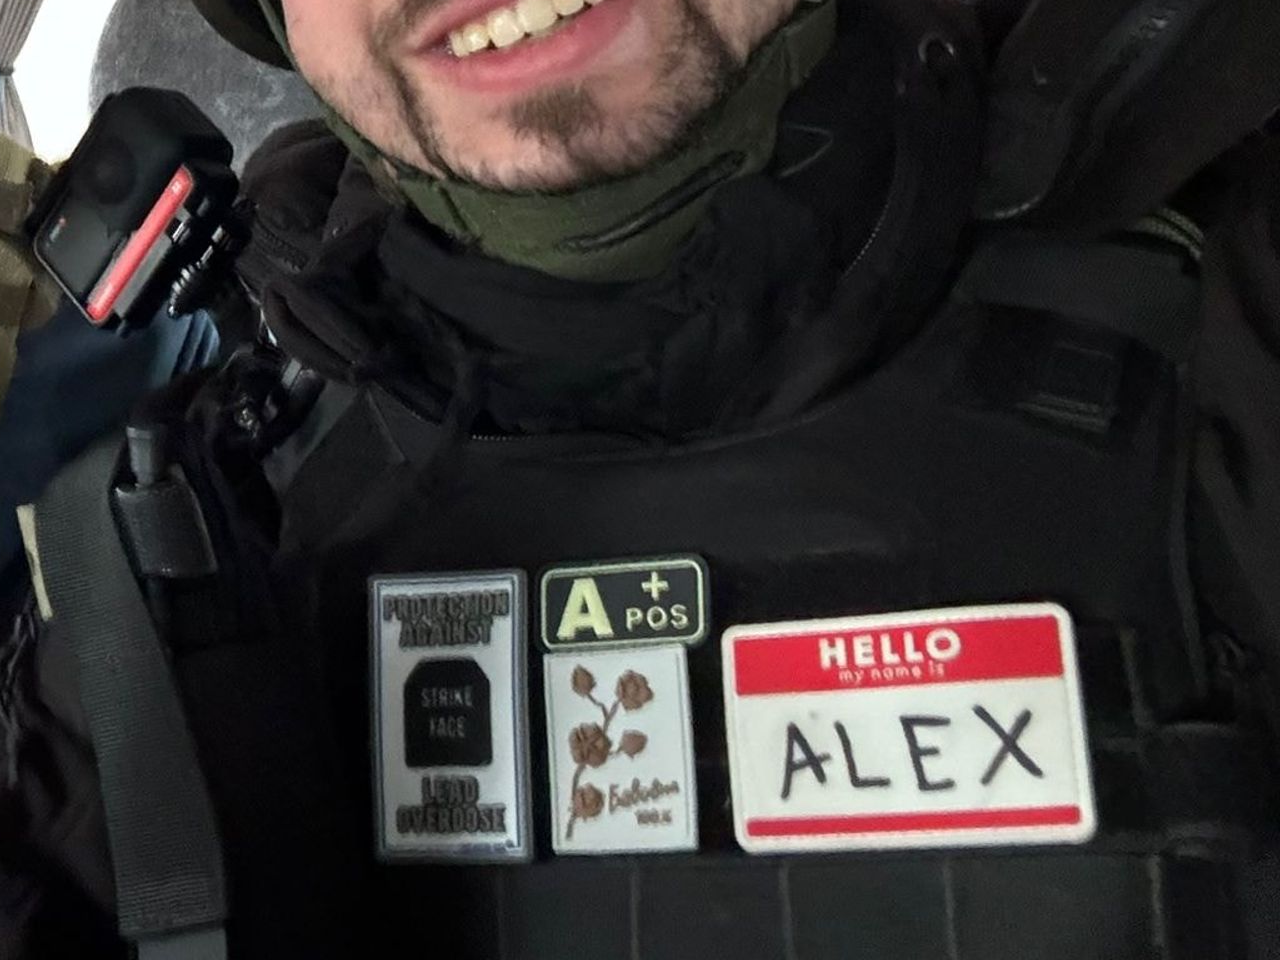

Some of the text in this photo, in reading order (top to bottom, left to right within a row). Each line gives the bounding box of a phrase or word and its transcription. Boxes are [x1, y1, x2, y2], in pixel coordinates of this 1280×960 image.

[383, 588, 510, 622] PROTECTION
[557, 577, 614, 640] A
[625, 604, 689, 632] POS
[819, 628, 962, 670] HELLO
[838, 659, 945, 685] my name is
[780, 704, 1044, 801] ALEX
[422, 774, 479, 806] LEAD
[396, 803, 507, 834] OVERDOSE
